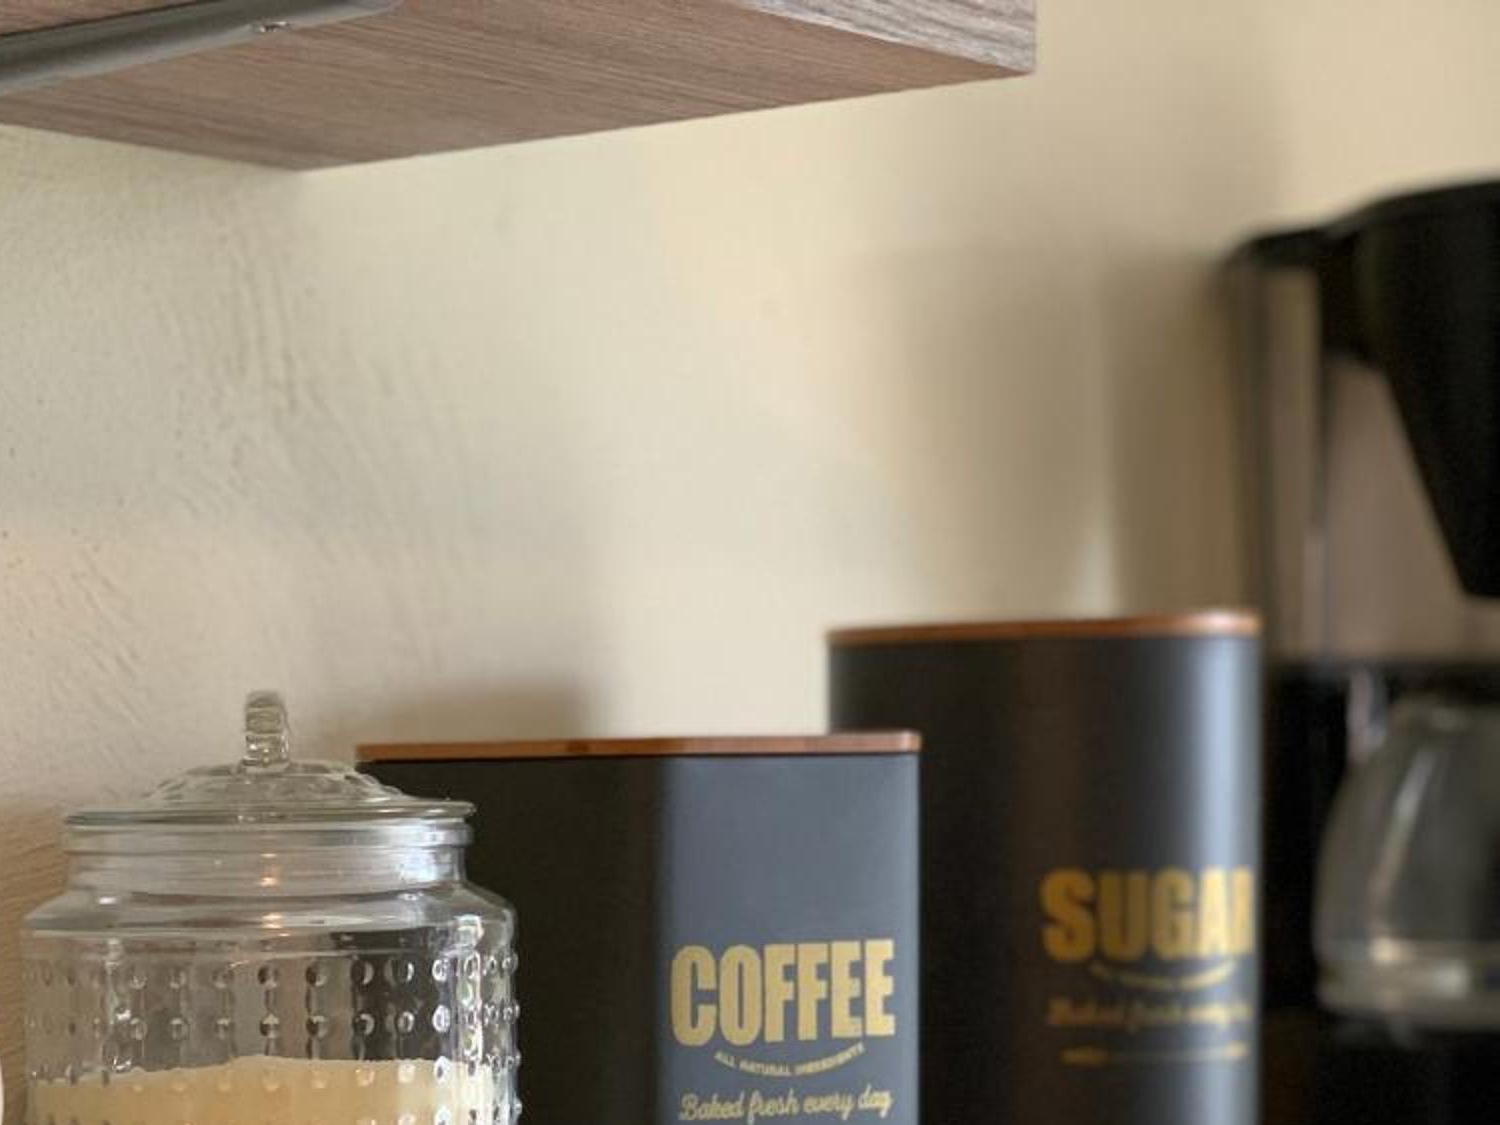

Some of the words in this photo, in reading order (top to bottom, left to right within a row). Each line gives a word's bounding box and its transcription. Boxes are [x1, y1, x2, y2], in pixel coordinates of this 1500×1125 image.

[671, 938, 895, 1046] COFFEE
[714, 1051, 737, 1069] ALL
[678, 1091, 744, 1120] Baked
[803, 1093, 854, 1121] every
[858, 1084, 892, 1118] day
